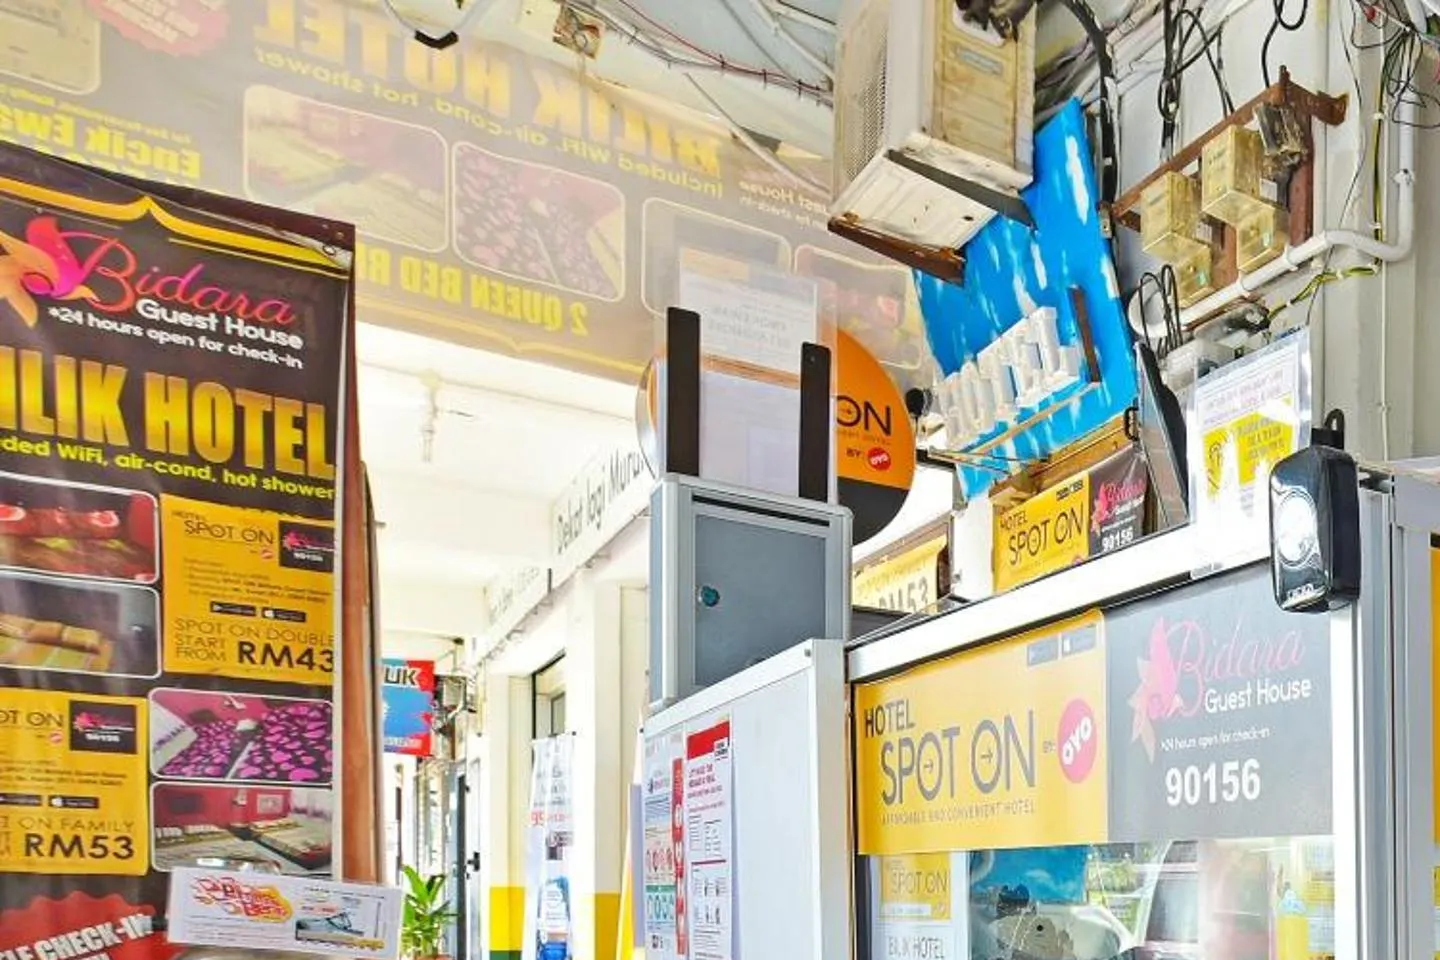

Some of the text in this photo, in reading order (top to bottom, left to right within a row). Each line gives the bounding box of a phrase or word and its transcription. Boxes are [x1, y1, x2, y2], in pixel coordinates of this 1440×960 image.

[60, 229, 297, 324] Bidara
[88, 312, 143, 338] hours
[148, 327, 195, 349] open
[199, 336, 224, 353] for
[228, 343, 303, 371] check-in
[136, 298, 303, 350] Guest House
[145, 372, 336, 481] HOTEL
[222, 467, 258, 490] hot
[261, 473, 336, 501] shower
[184, 519, 274, 545] SPOT ON
[1008, 519, 1051, 566] SPOT
[1054, 503, 1085, 545] ON
[174, 618, 222, 636] SPOT
[229, 624, 260, 640] ON
[237, 641, 334, 673] RM43
[1165, 615, 1305, 718] Bidara
[864, 697, 917, 739] HOTEL
[1203, 674, 1312, 714] Guest House
[880, 709, 1036, 807] SPOT ON
[1061, 715, 1092, 766] OYO
[1165, 758, 1261, 807] 90156
[25, 833, 134, 860] RM53
[60, 818, 135, 834] FAMILY
